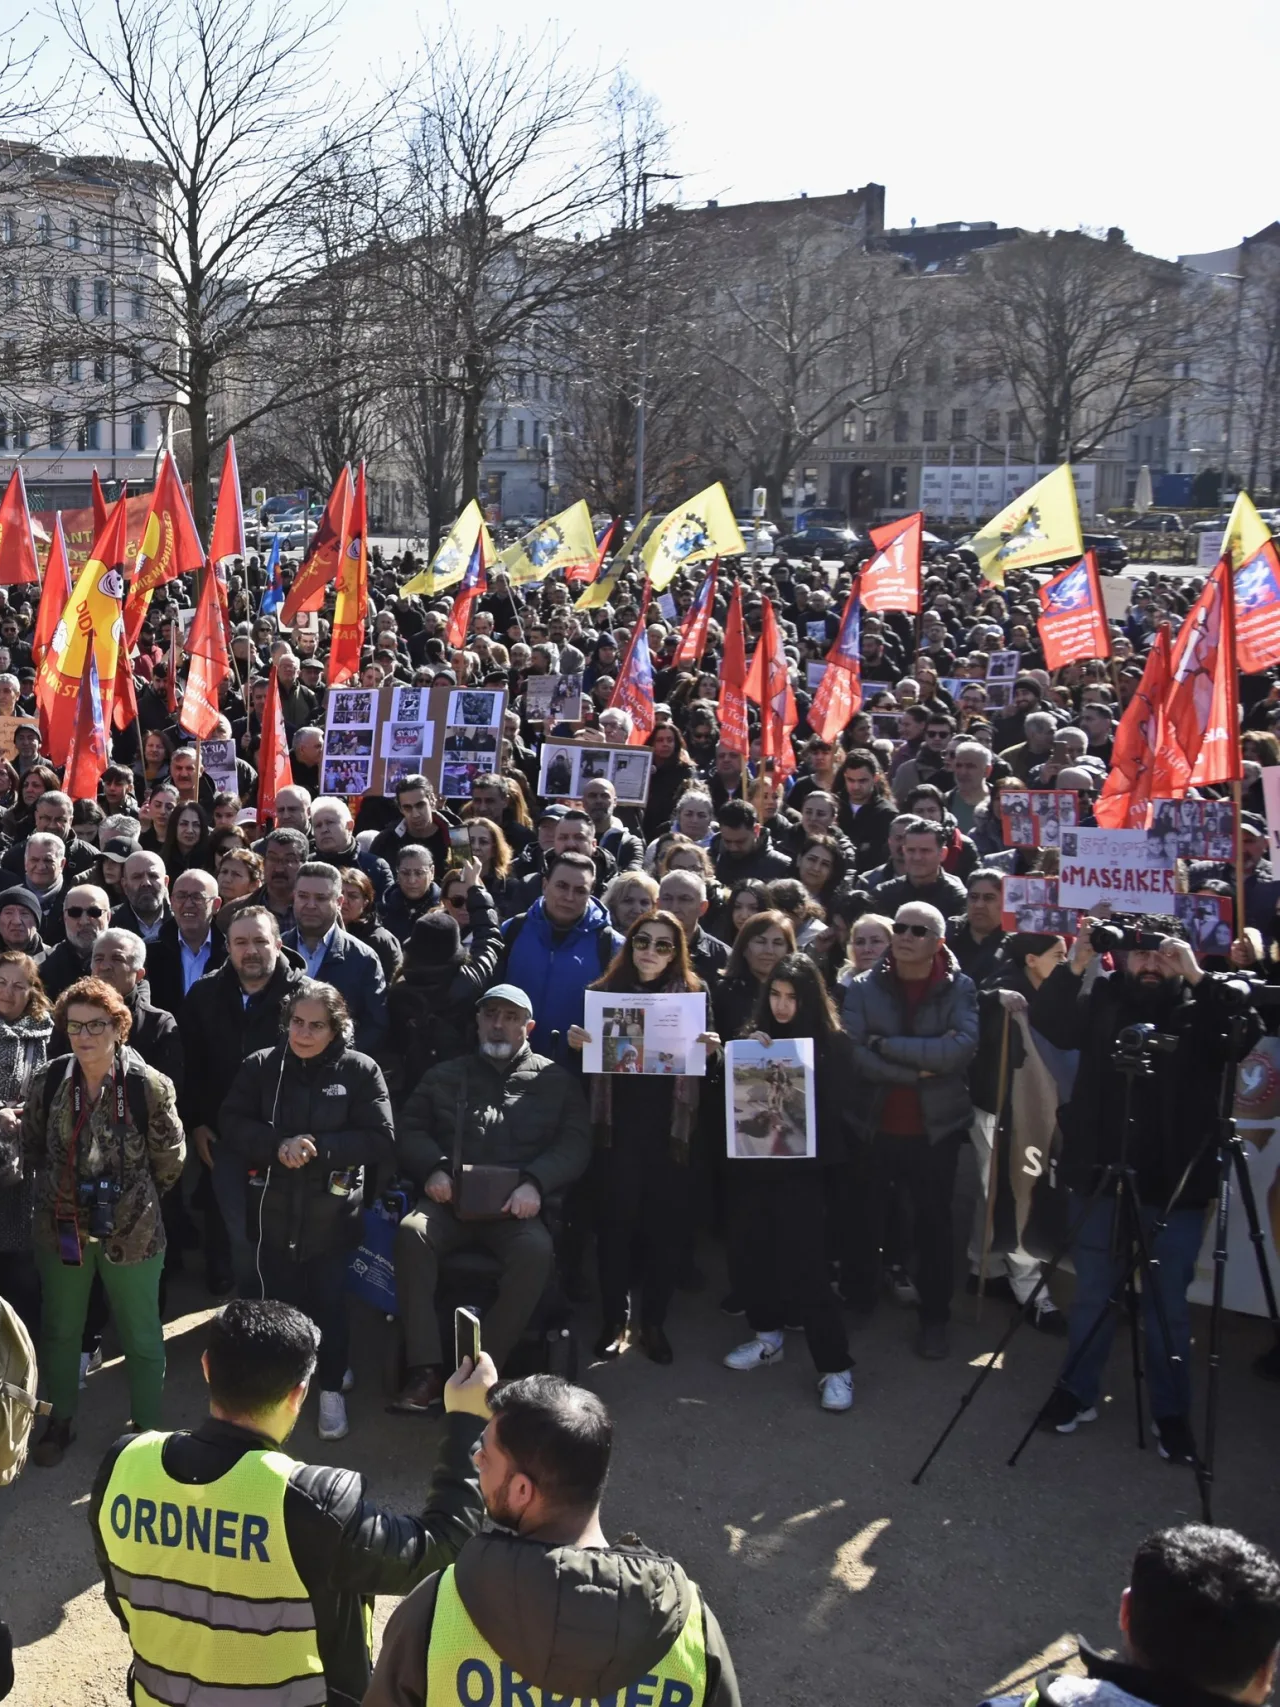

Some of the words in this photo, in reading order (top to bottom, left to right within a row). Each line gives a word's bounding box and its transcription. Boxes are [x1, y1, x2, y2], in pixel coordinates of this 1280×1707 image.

[62, 684, 114, 702] STRK
[1070, 865, 1175, 895] MASSAKER
[117, 1099, 125, 1118] EOS
[110, 1493, 271, 1563] ORDNER
[456, 1656, 694, 1707] ORER
